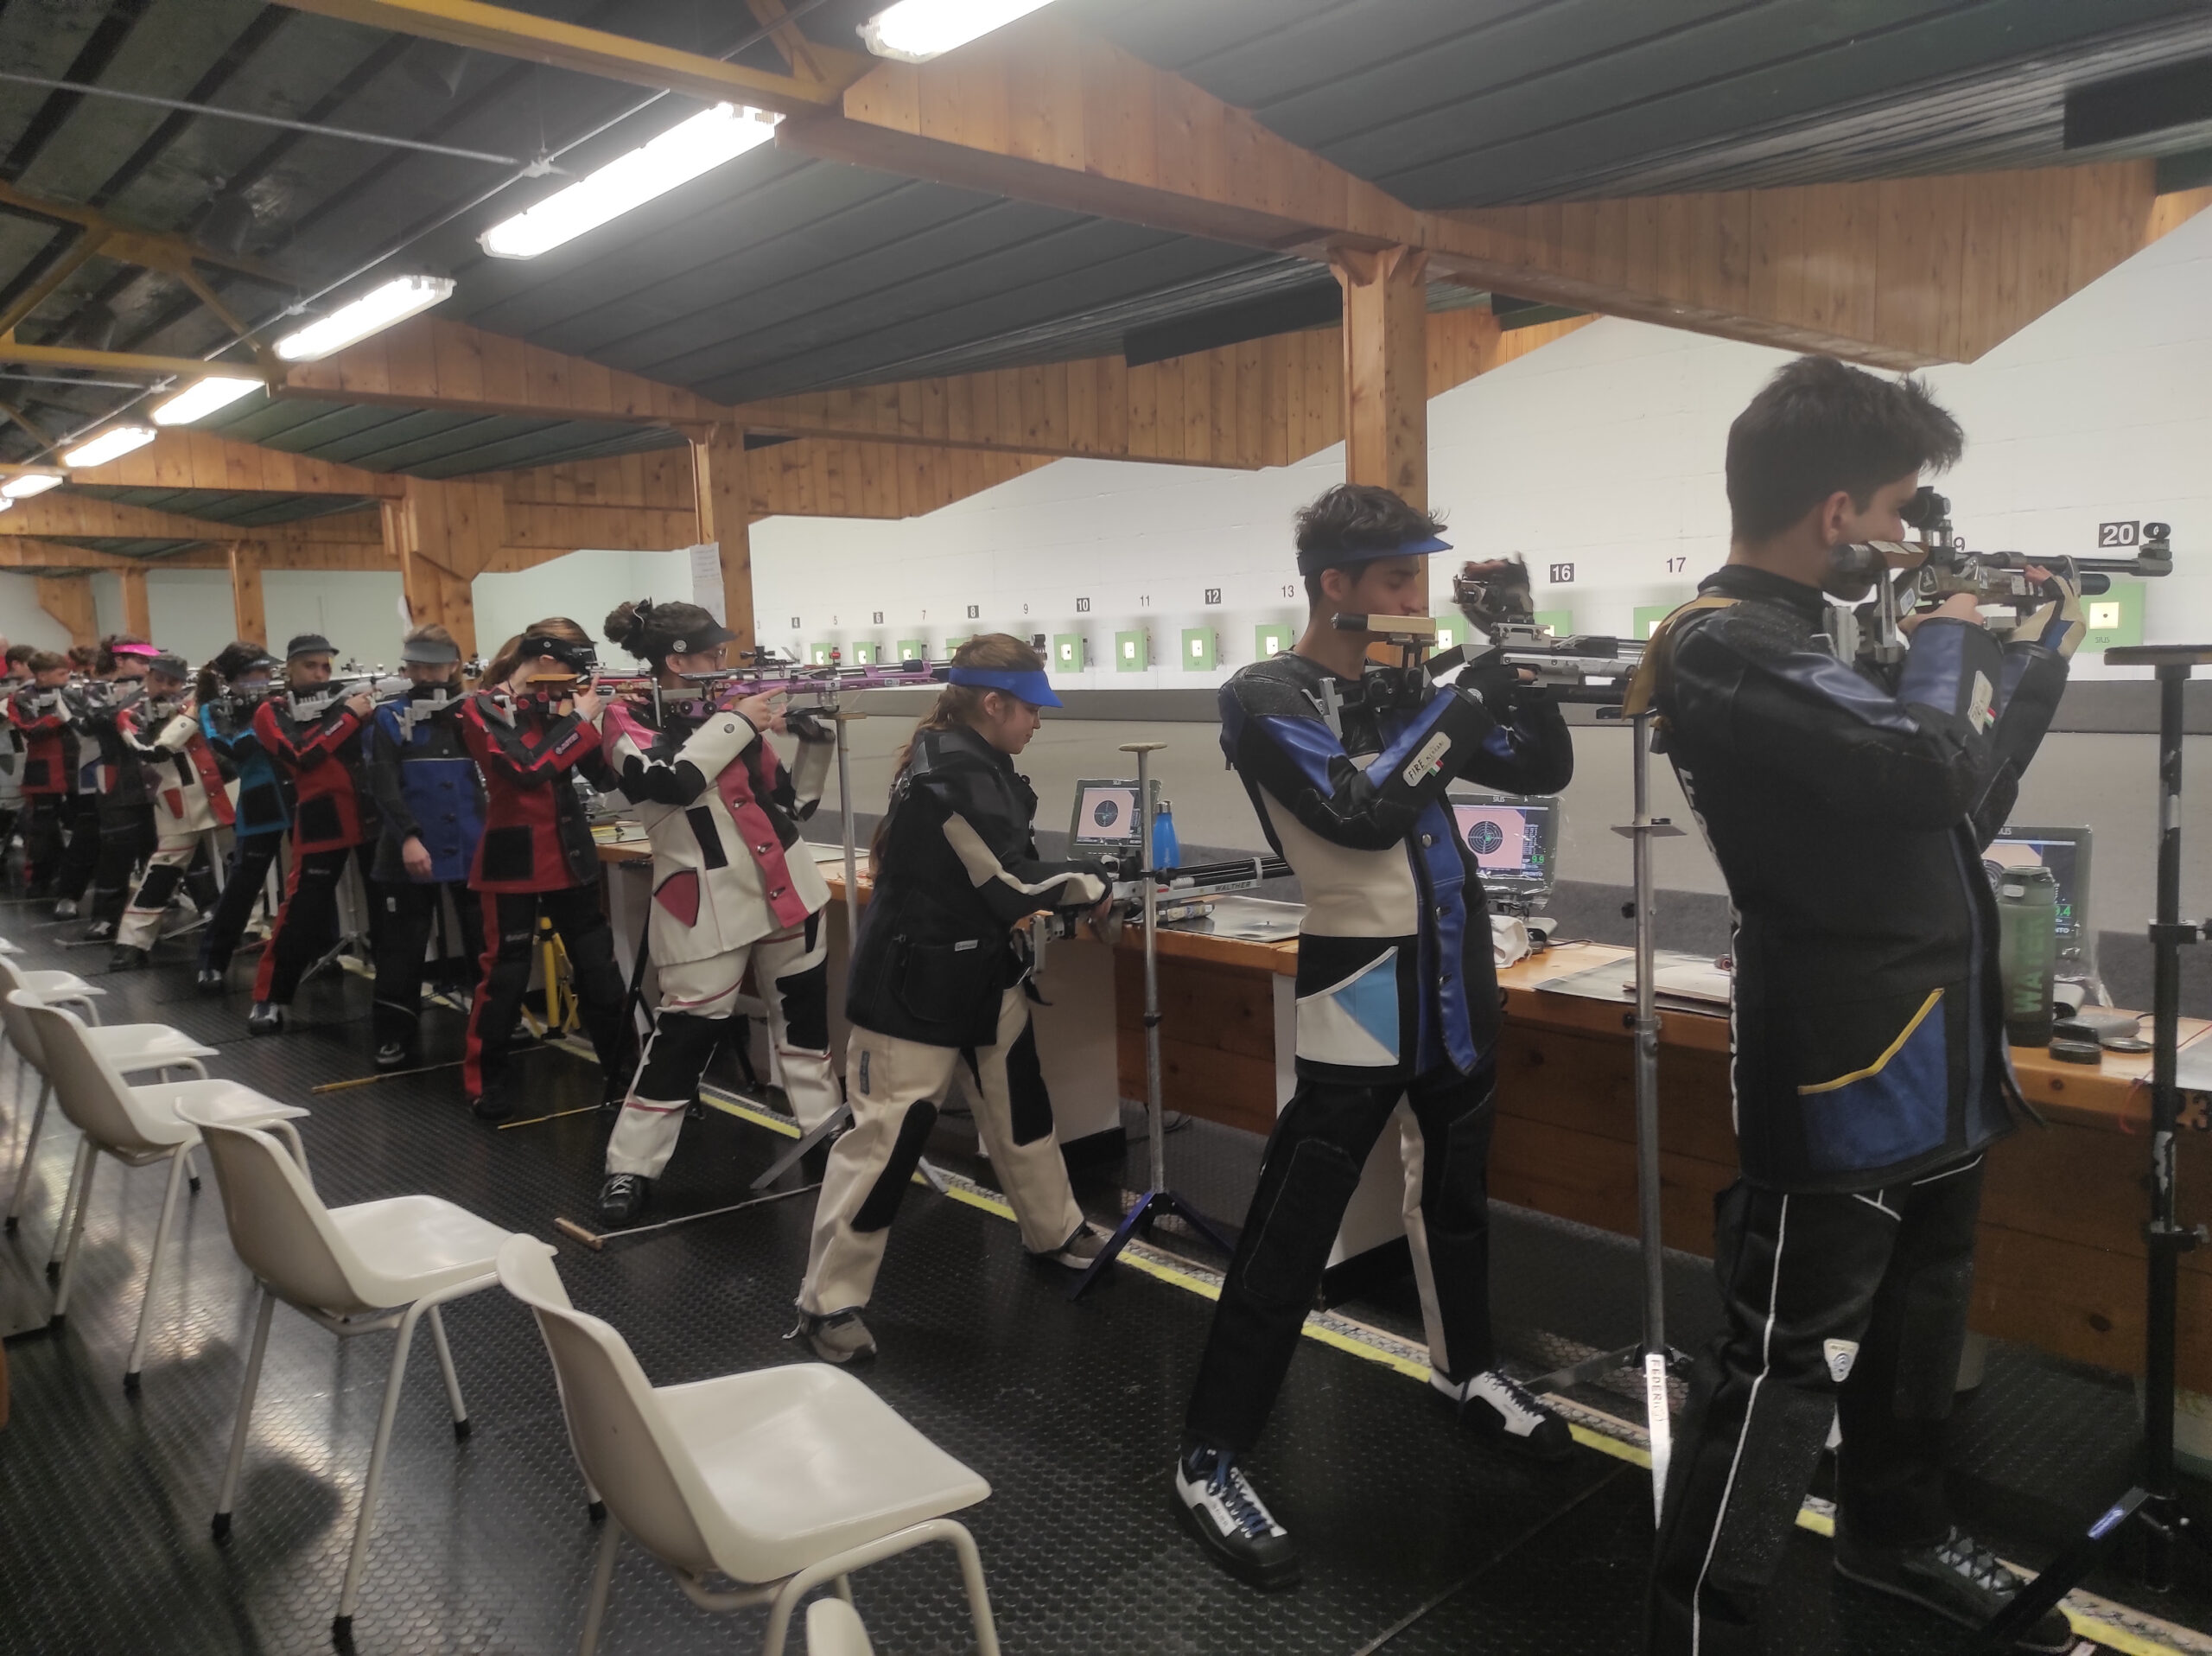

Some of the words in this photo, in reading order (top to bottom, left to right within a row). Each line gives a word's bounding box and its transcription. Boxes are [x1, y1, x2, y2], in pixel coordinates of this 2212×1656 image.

[2102, 523, 2134, 545] 20
[1666, 557, 1687, 573] 17
[1552, 564, 1571, 582] 16
[1206, 589, 1220, 603] 12
[1281, 584, 1294, 598] 13
[1077, 598, 1089, 612] 10
[1140, 595, 1150, 607] 11
[921, 609, 926, 621] 7
[969, 606, 976, 618] 8
[1023, 603, 1029, 615] 9
[792, 617, 800, 628] 4
[833, 615, 838, 625] 5
[874, 612, 881, 624] 6
[1408, 759, 1425, 780] FIRE
[1215, 881, 1251, 892] WALTHER
